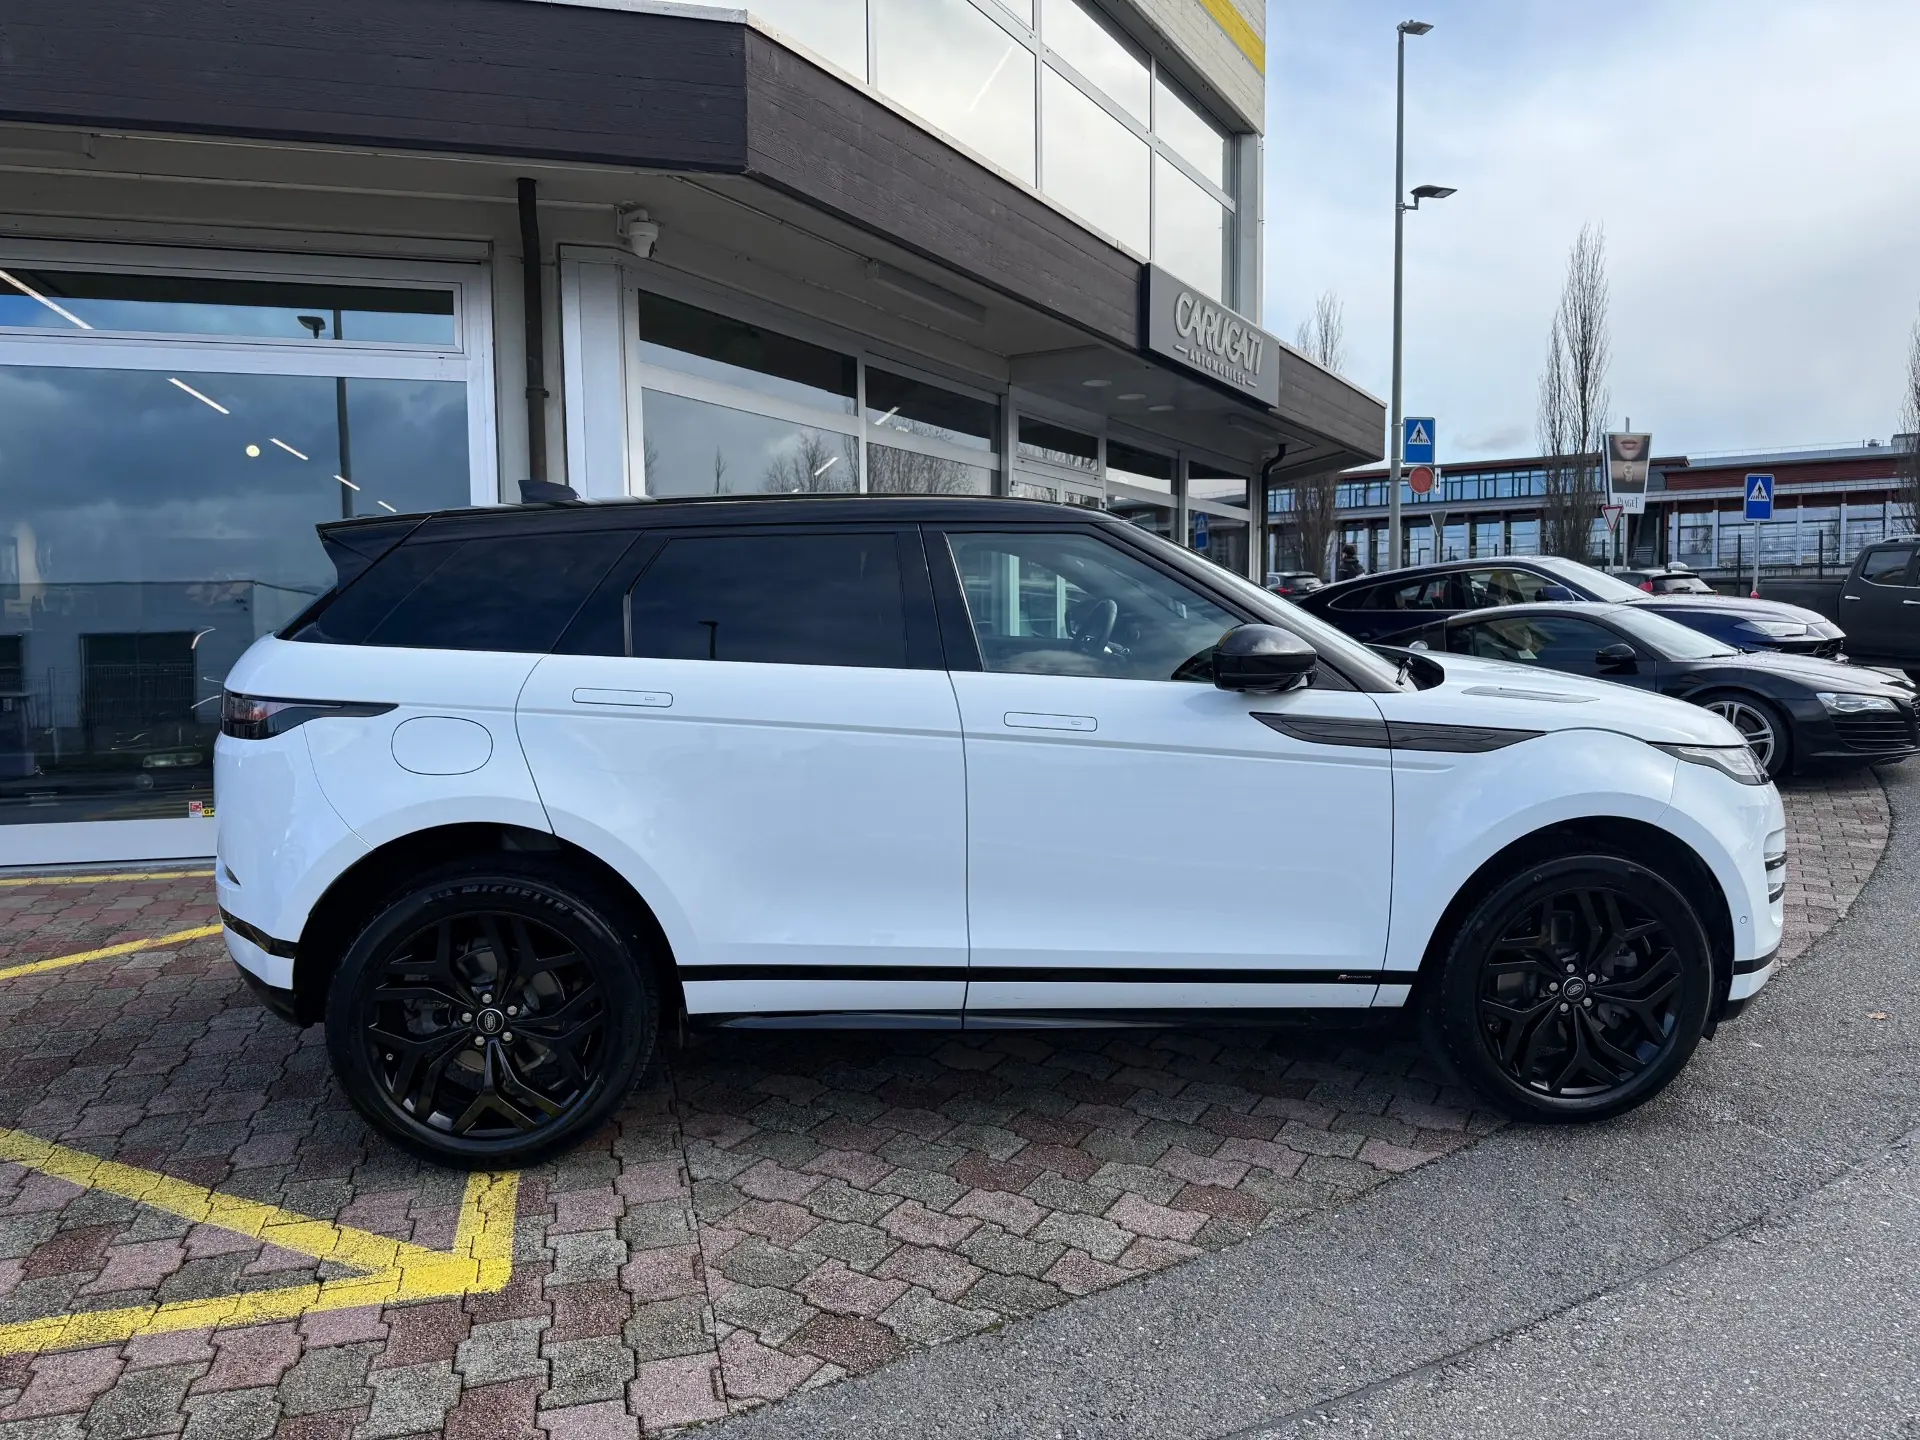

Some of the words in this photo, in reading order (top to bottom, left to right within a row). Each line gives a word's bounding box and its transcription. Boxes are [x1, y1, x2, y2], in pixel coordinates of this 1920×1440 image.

[1175, 291, 1264, 376] CARUGATI
[1188, 348, 1247, 386] AUTOMOBILES
[1616, 496, 1640, 509] PIAGET
[461, 883, 570, 916] MICHELIN
